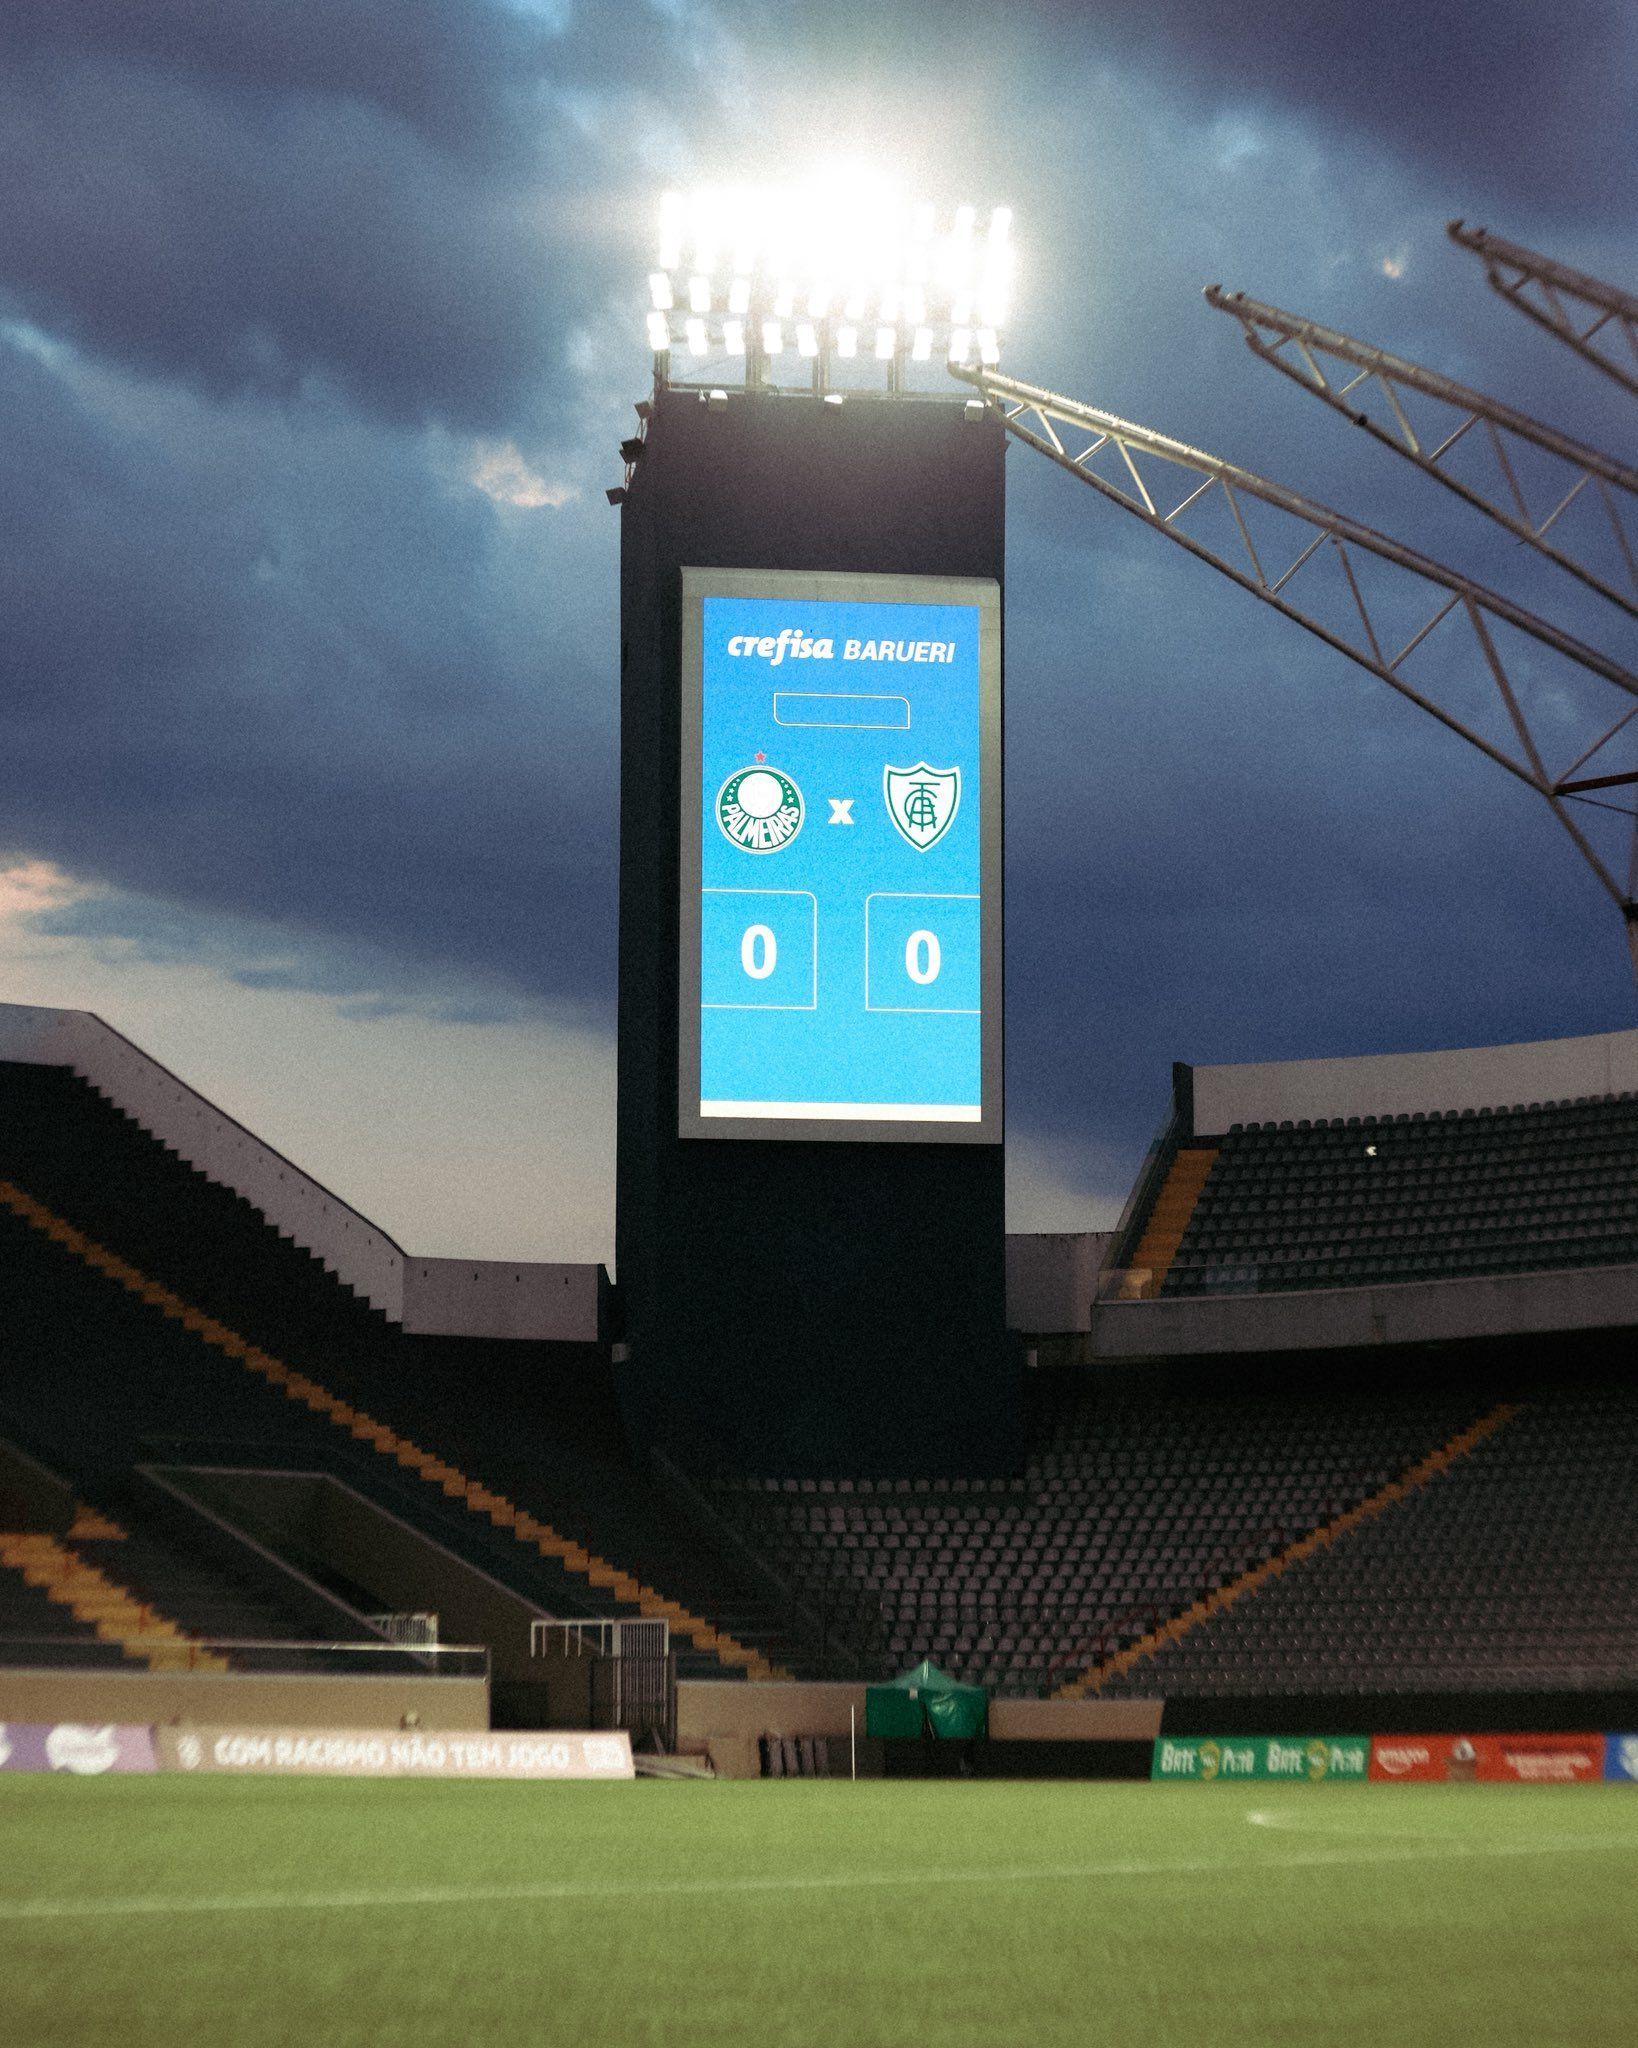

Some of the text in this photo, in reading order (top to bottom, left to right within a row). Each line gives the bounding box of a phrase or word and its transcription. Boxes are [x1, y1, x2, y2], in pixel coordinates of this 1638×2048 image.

[727, 628, 956, 666] crefisa BARUERI
[720, 803, 800, 849] PALMEIRAS
[740, 924, 778, 980] 0
[905, 929, 941, 985] 0
[214, 1735, 271, 1766] COM
[274, 1735, 387, 1768] RACISMO
[390, 1733, 446, 1768] NÃO
[448, 1742, 503, 1768] TEM
